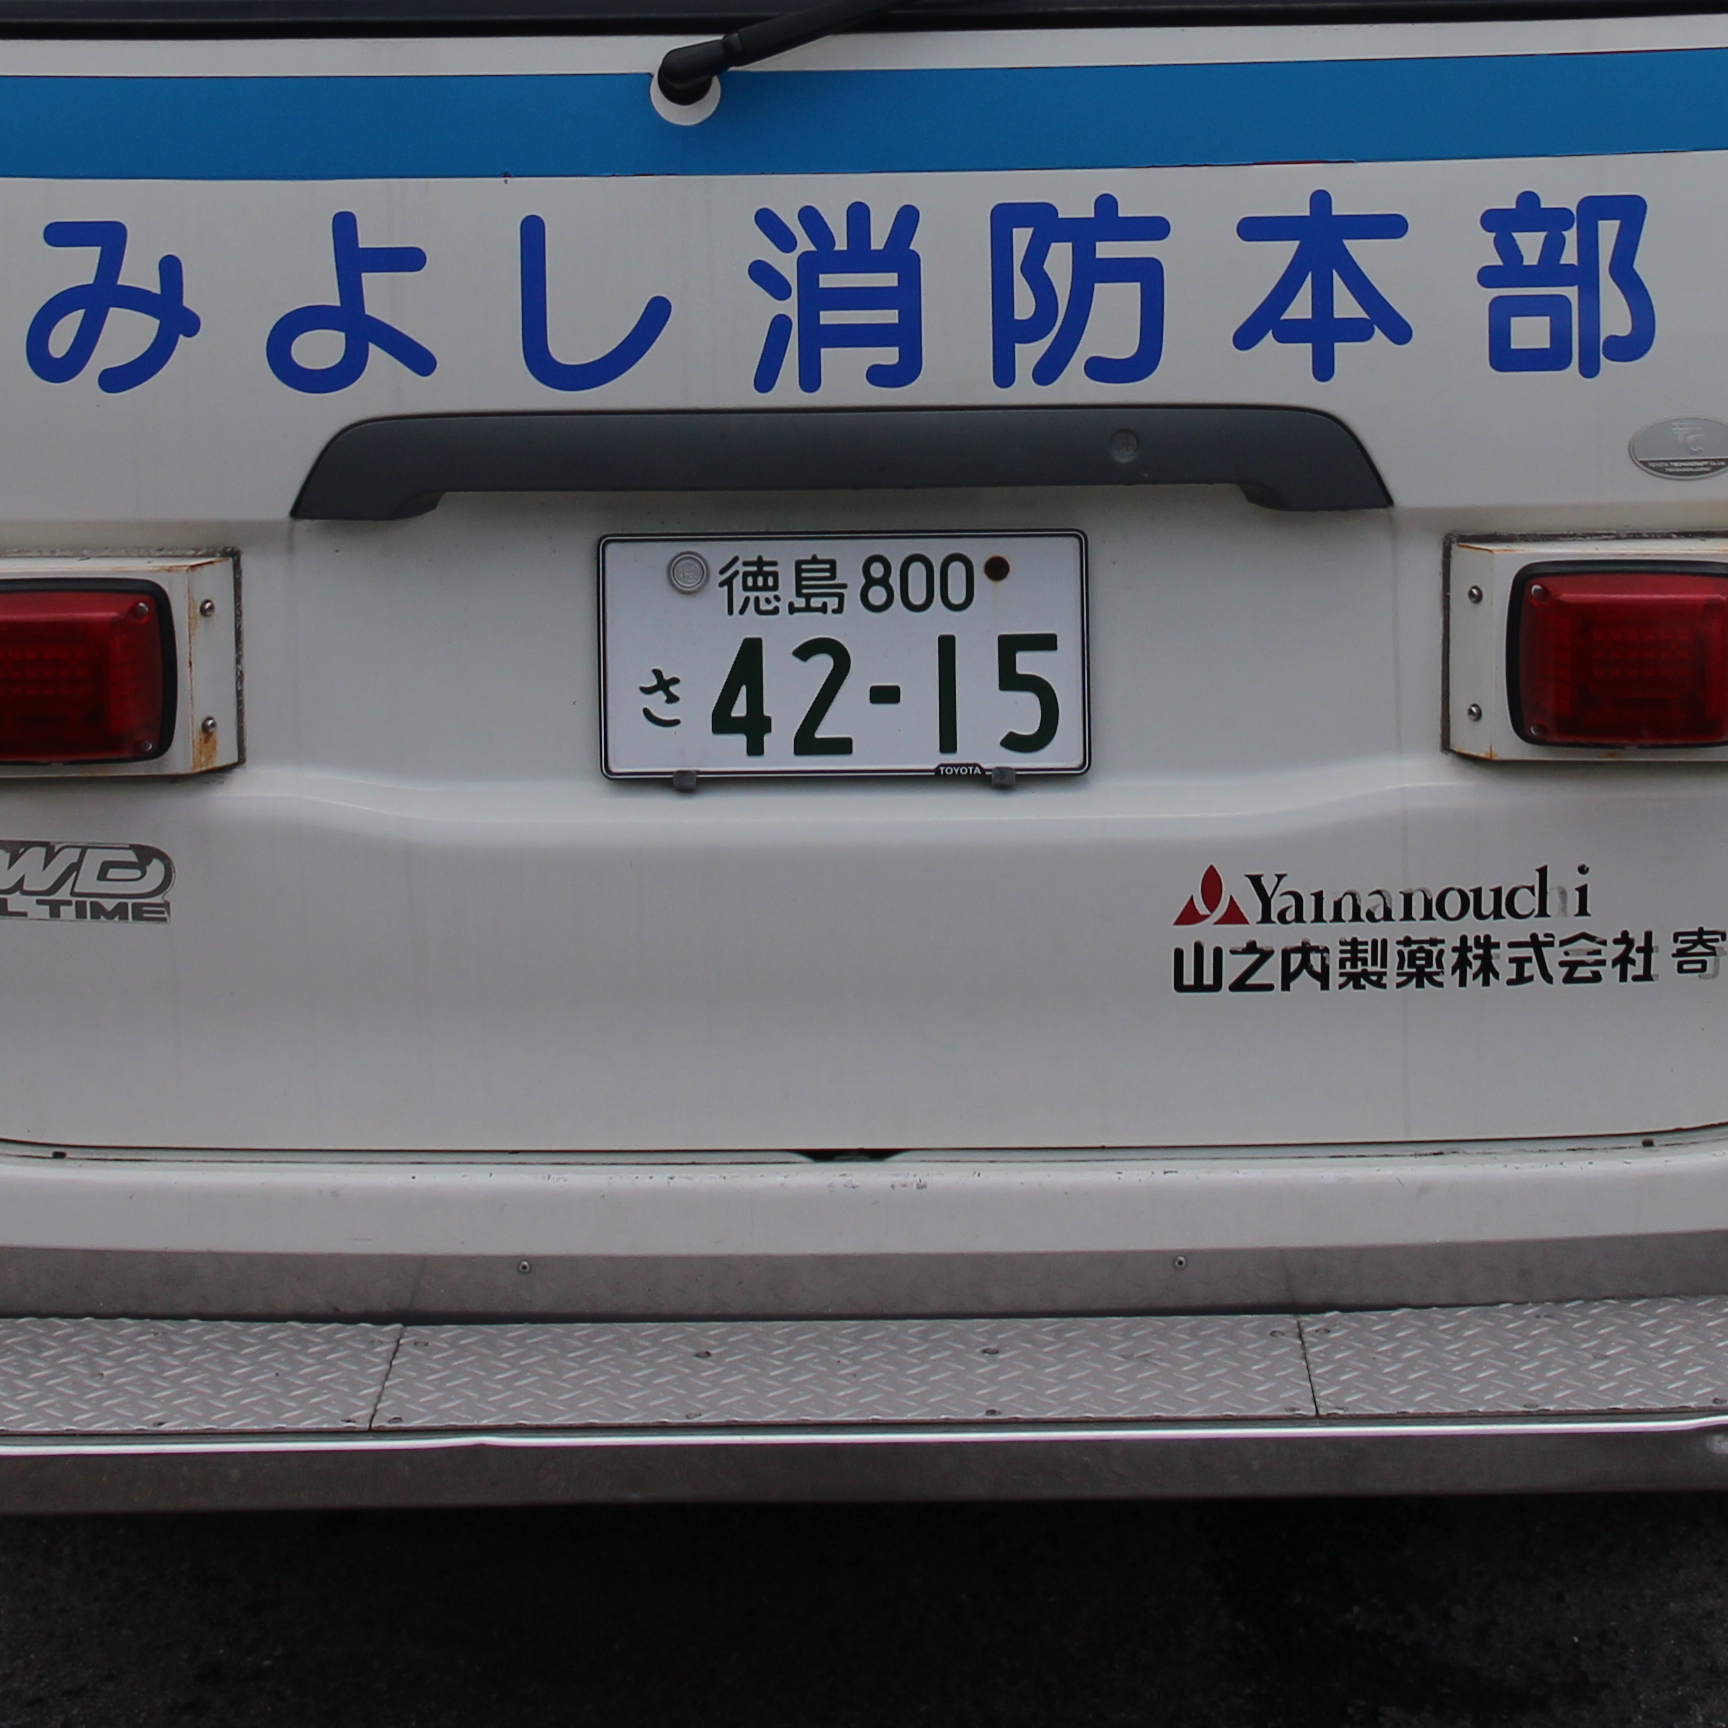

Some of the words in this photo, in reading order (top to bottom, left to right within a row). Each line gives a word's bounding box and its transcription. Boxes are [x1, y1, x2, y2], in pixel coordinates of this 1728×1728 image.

[26, 189, 1656, 394] みよし消防本部
[638, 668, 682, 728] さ
[711, 633, 1060, 756] 42-15
[939, 765, 982, 776] TOYOTA
[35, 897, 171, 923] TIME
